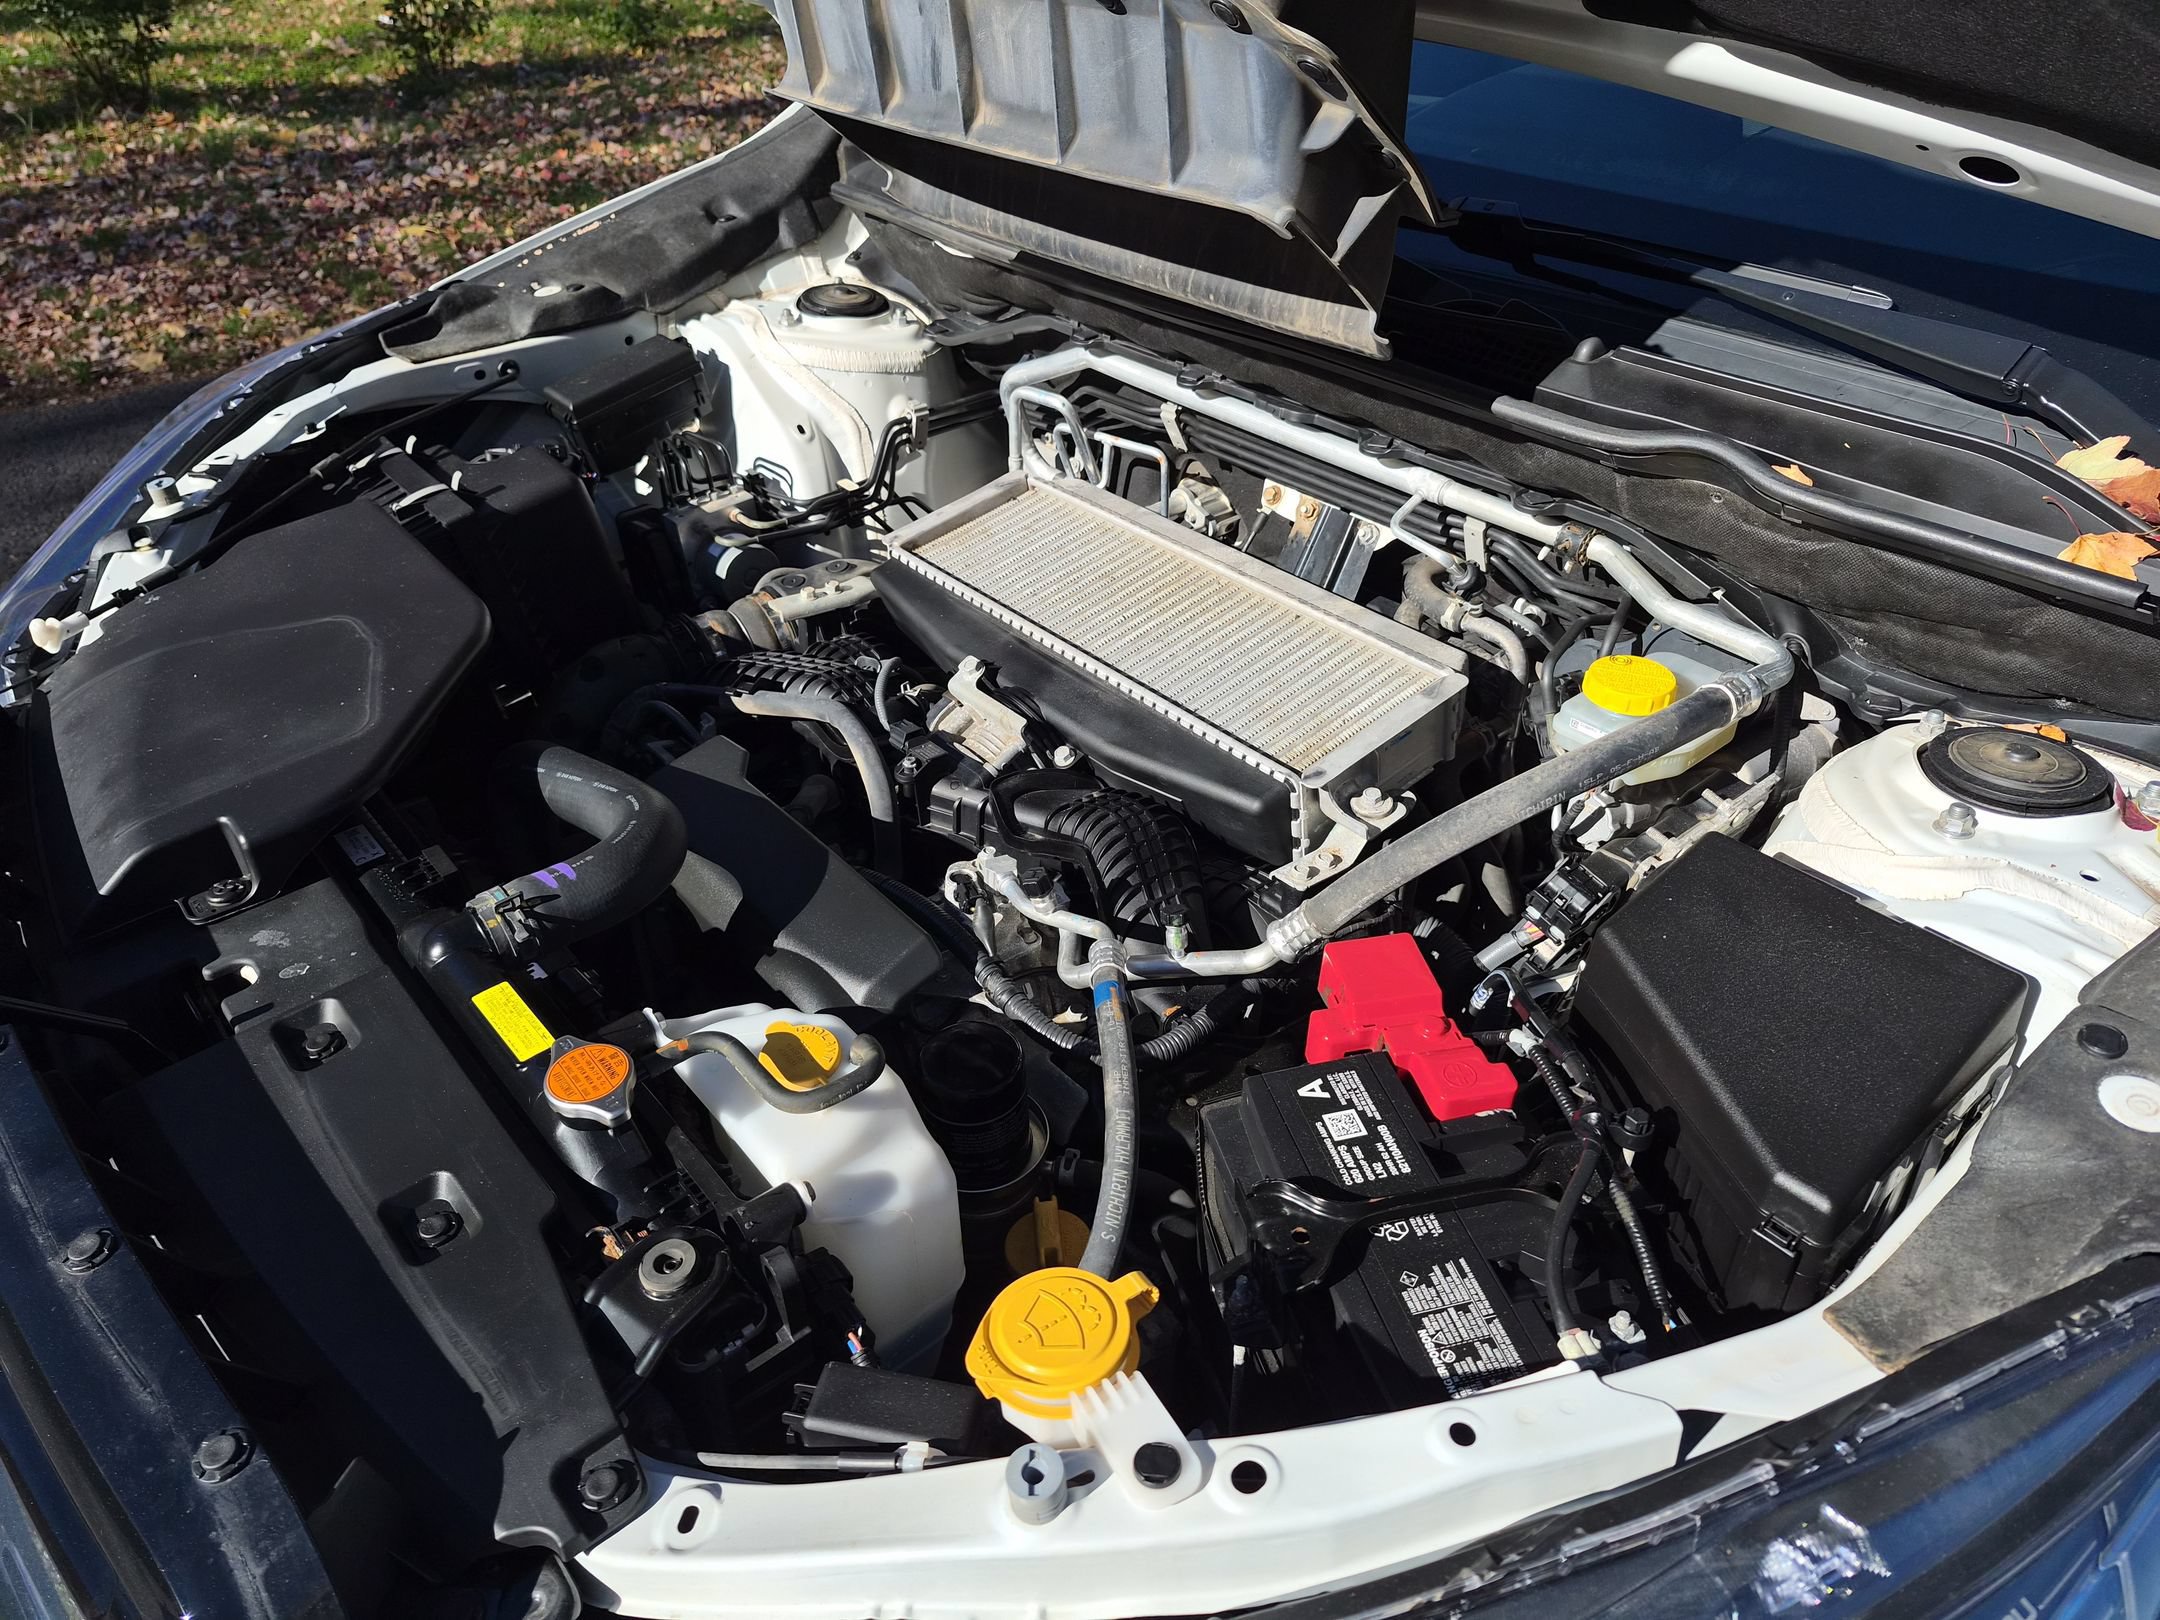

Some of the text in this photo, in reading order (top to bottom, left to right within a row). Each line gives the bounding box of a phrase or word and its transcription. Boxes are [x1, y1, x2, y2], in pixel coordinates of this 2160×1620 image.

[1297, 1078, 1331, 1099] A
[1114, 1107, 1131, 1165] HYLAMMIT
[1314, 1121, 1353, 1185] COLD CRANKING AMPS
[1374, 1142, 1386, 1152] AH
[1376, 1124, 1411, 1173] 82110AN00B
[1336, 1144, 1364, 1183] 620 AMPS
[1351, 1145, 1376, 1180] GROUP SIZE
[1371, 1161, 1388, 1178] LN2
[1416, 1329, 1461, 1399] ANGER/POISON
